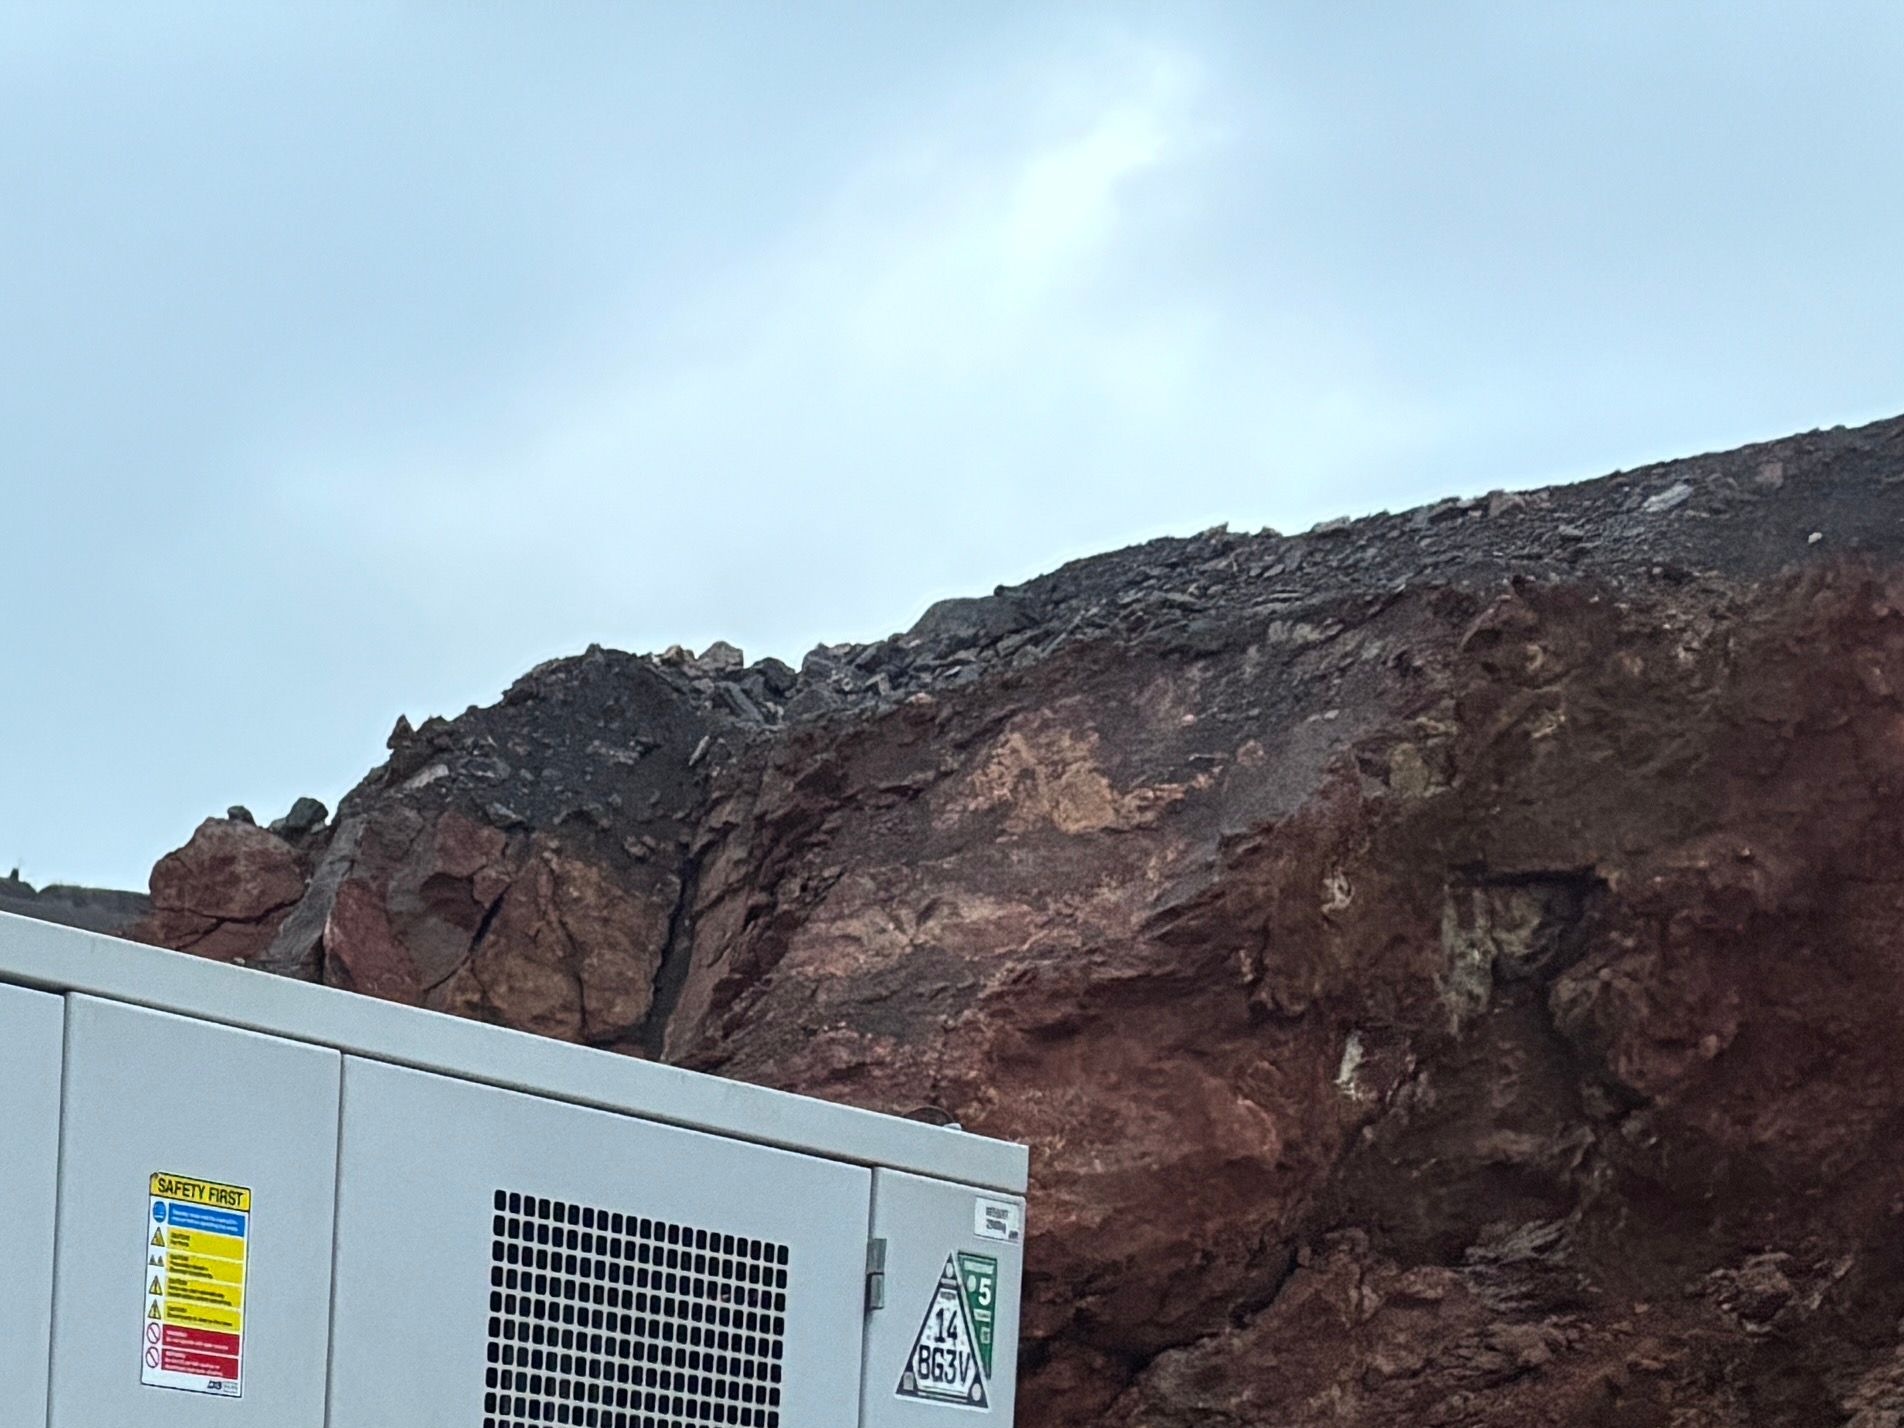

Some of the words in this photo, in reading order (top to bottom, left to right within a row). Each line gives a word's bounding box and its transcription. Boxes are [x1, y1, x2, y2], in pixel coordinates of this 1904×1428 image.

[158, 1178, 205, 1199] SAFETY
[208, 1187, 244, 1206] FIRST
[978, 1277, 992, 1306] 5
[934, 1307, 958, 1346] 14
